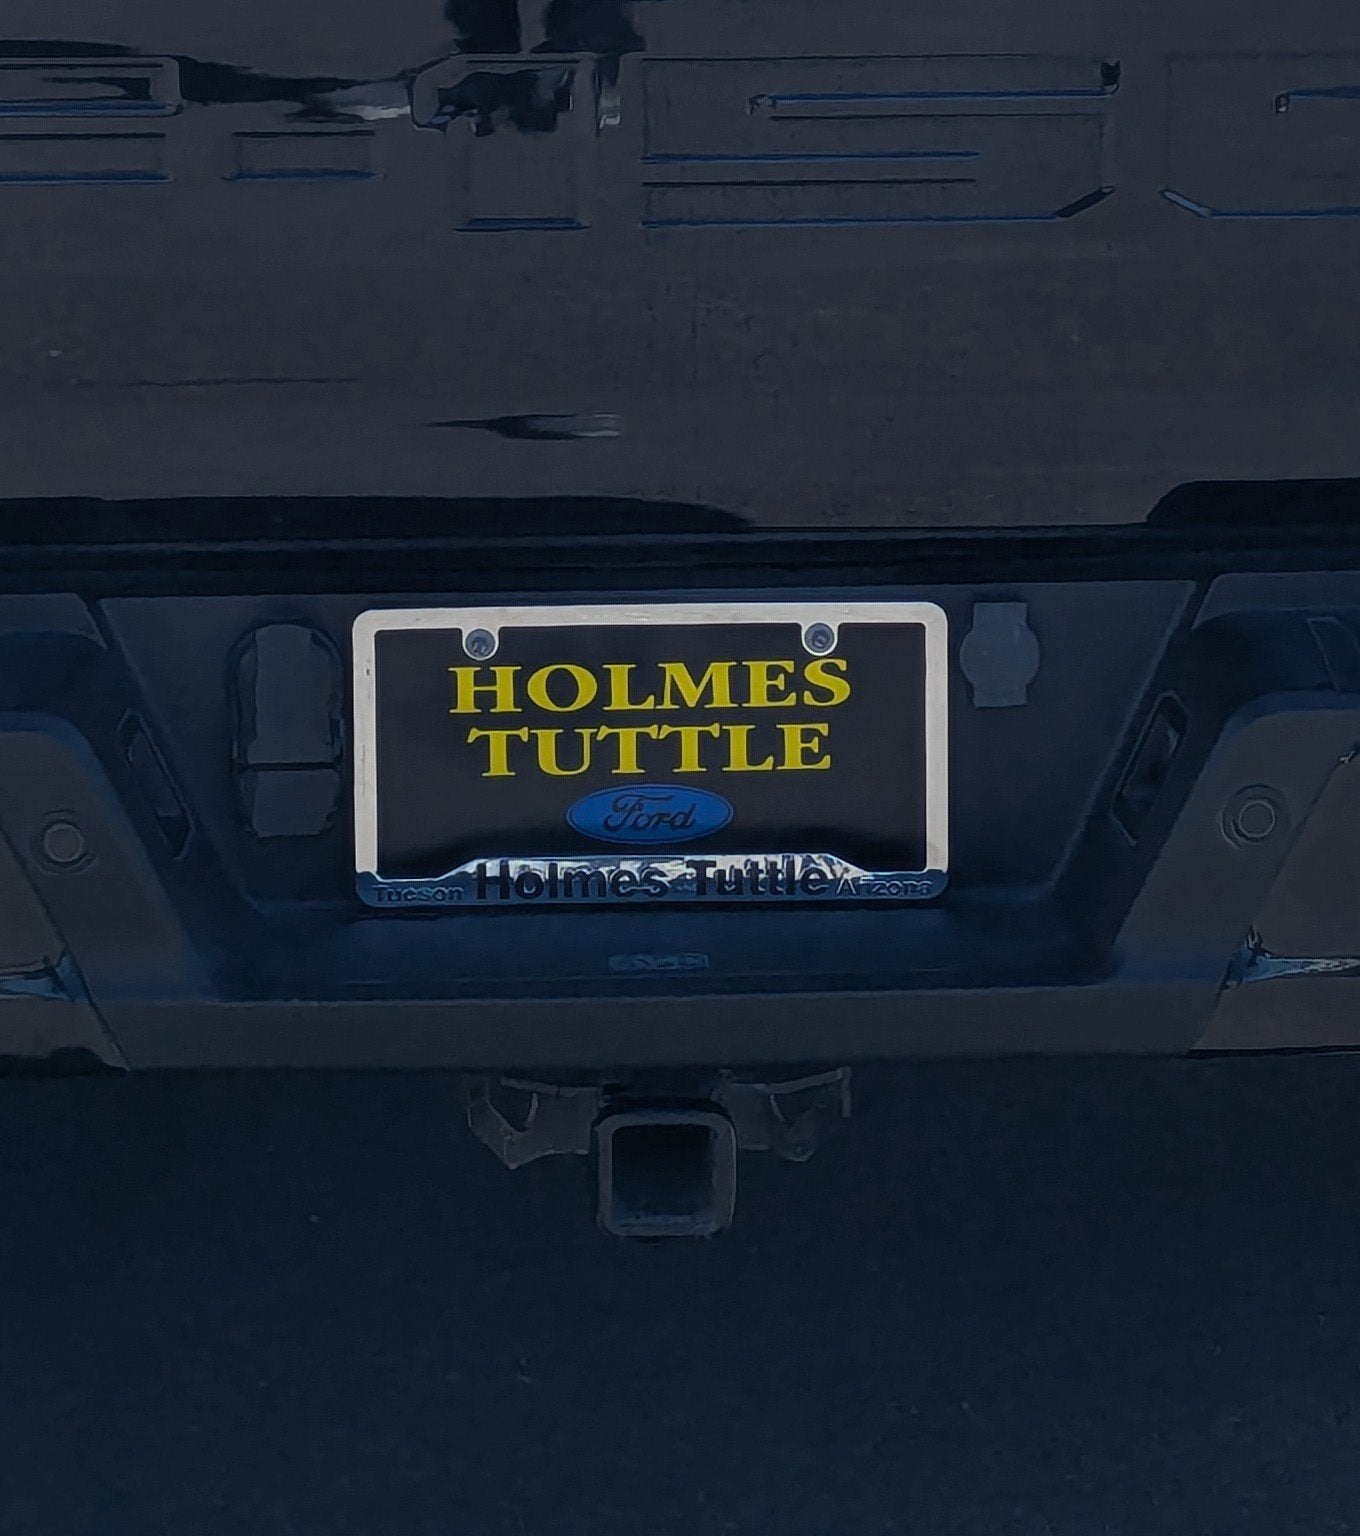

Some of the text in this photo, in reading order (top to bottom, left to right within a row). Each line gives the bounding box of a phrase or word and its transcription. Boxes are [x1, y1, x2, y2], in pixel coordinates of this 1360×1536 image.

[448, 658, 851, 714] HOLMES
[466, 722, 832, 778] TUTTLE
[603, 793, 696, 833] Ford
[371, 883, 464, 902] Tucson
[476, 858, 669, 900] Holmes
[686, 855, 830, 897] Tuttle
